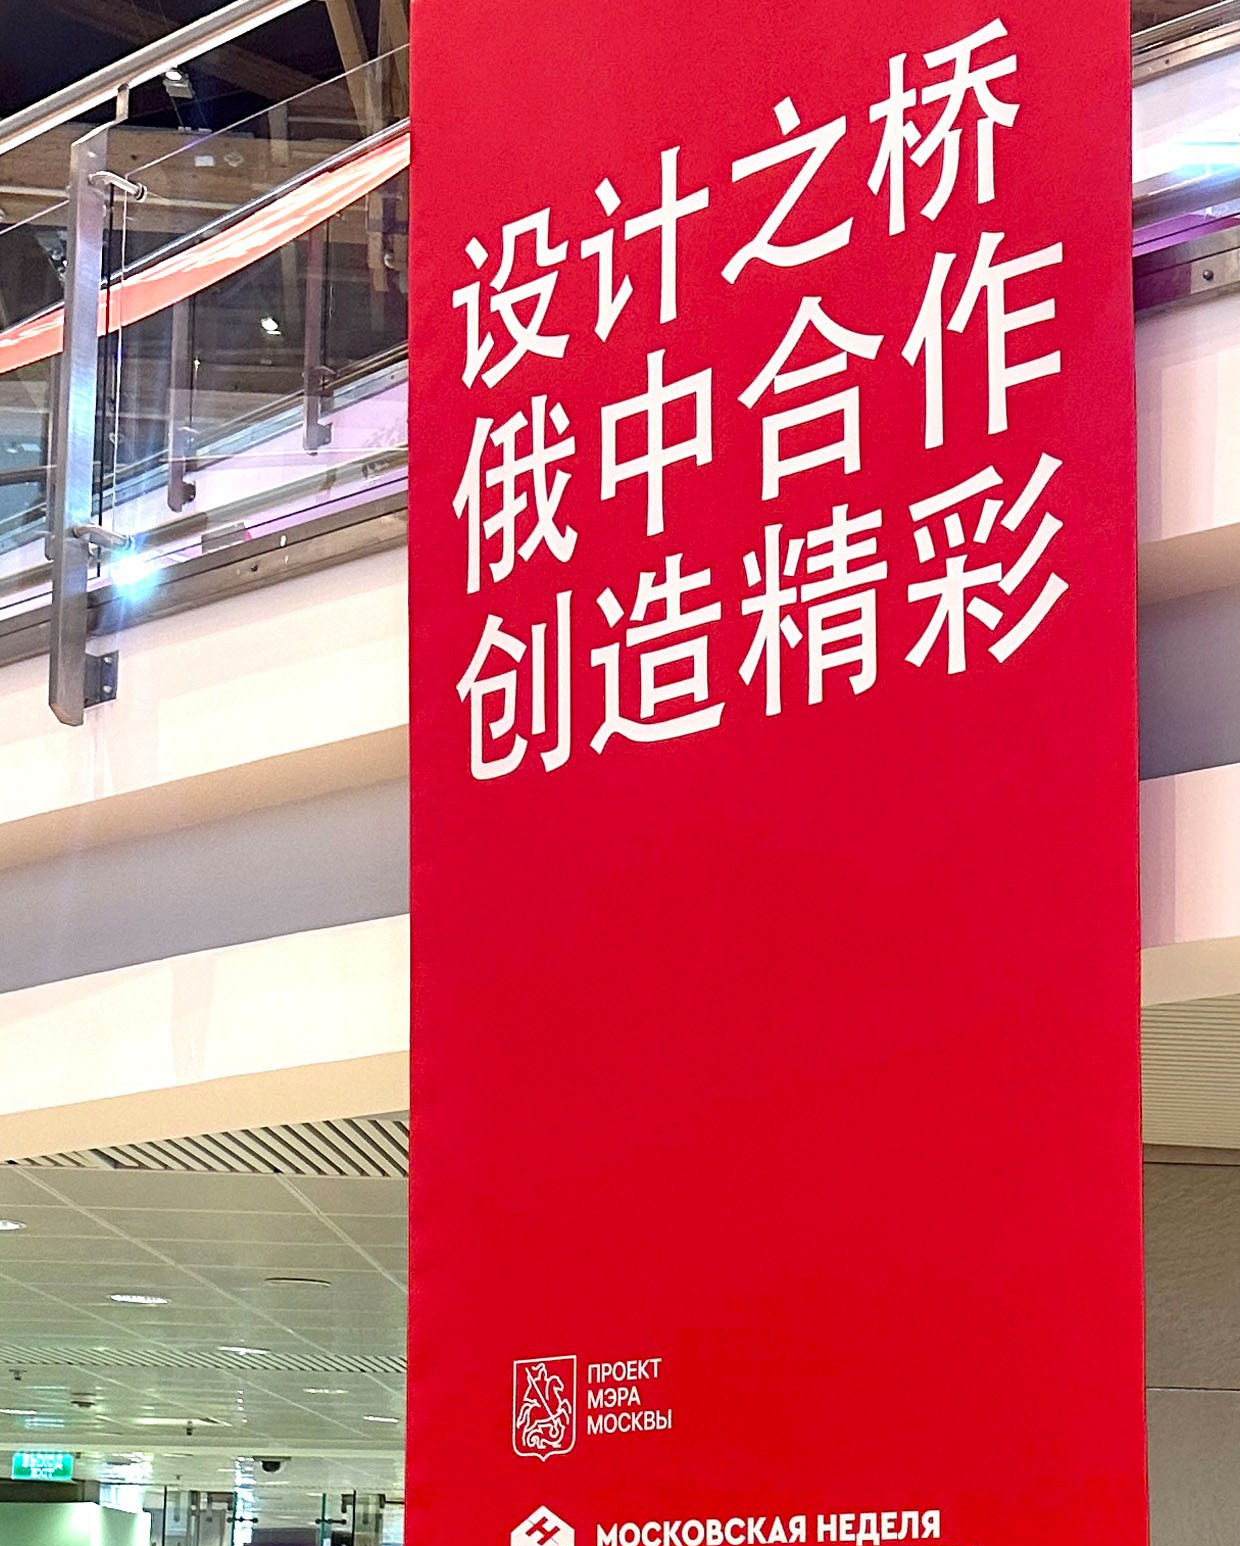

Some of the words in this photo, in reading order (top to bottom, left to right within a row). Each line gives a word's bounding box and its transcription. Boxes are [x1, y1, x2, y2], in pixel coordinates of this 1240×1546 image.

[452, 17, 1022, 390] 设计之桥
[452, 231, 1065, 594] 俄中合作
[455, 452, 1070, 780] 创造精彩
[587, 1357, 663, 1384] ПРОЕКТ
[587, 1385, 641, 1409] МЭРА
[586, 1408, 673, 1435] МОСКВЫ
[816, 1509, 942, 1546] НЕДЕЛЯ
